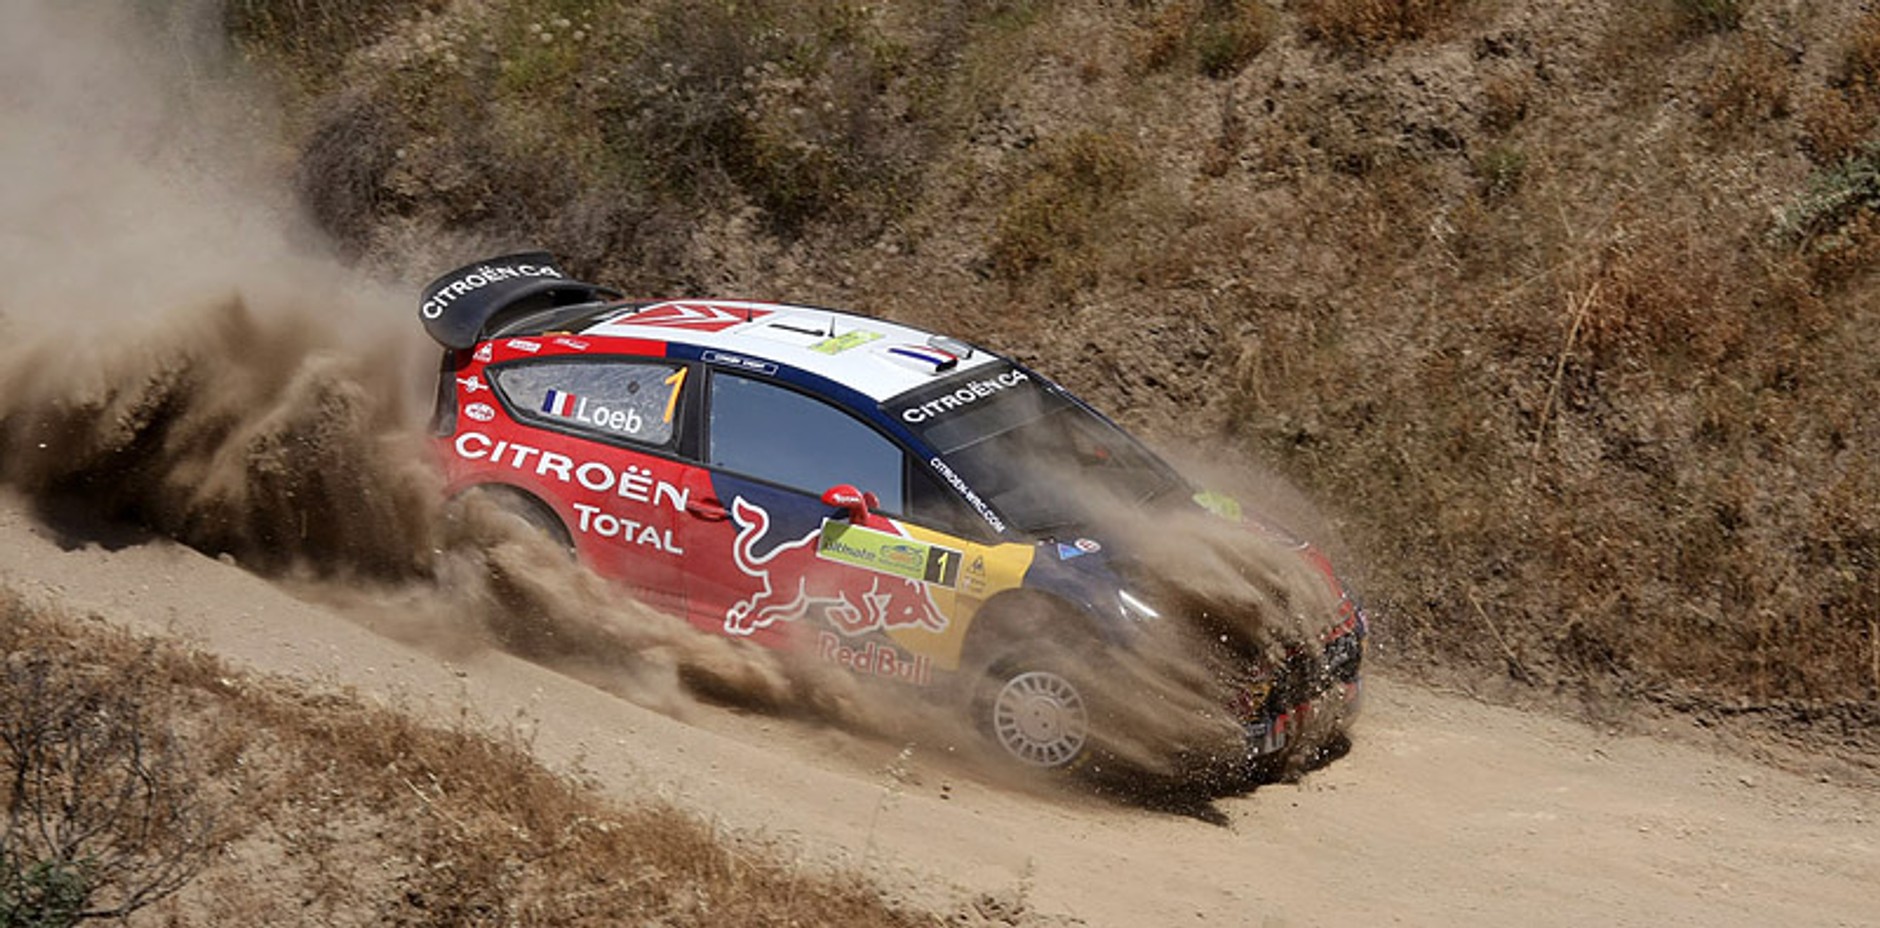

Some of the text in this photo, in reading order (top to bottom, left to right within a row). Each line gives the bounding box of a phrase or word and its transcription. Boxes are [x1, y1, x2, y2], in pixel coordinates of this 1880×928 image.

[423, 264, 563, 319] CITROËN C4
[575, 396, 643, 434] Loeb
[664, 366, 689, 424] 1
[902, 369, 1029, 423] CITROËN C4
[455, 432, 690, 512] CITROËN
[937, 551, 950, 584] 1
[819, 630, 934, 687] Red Bull
